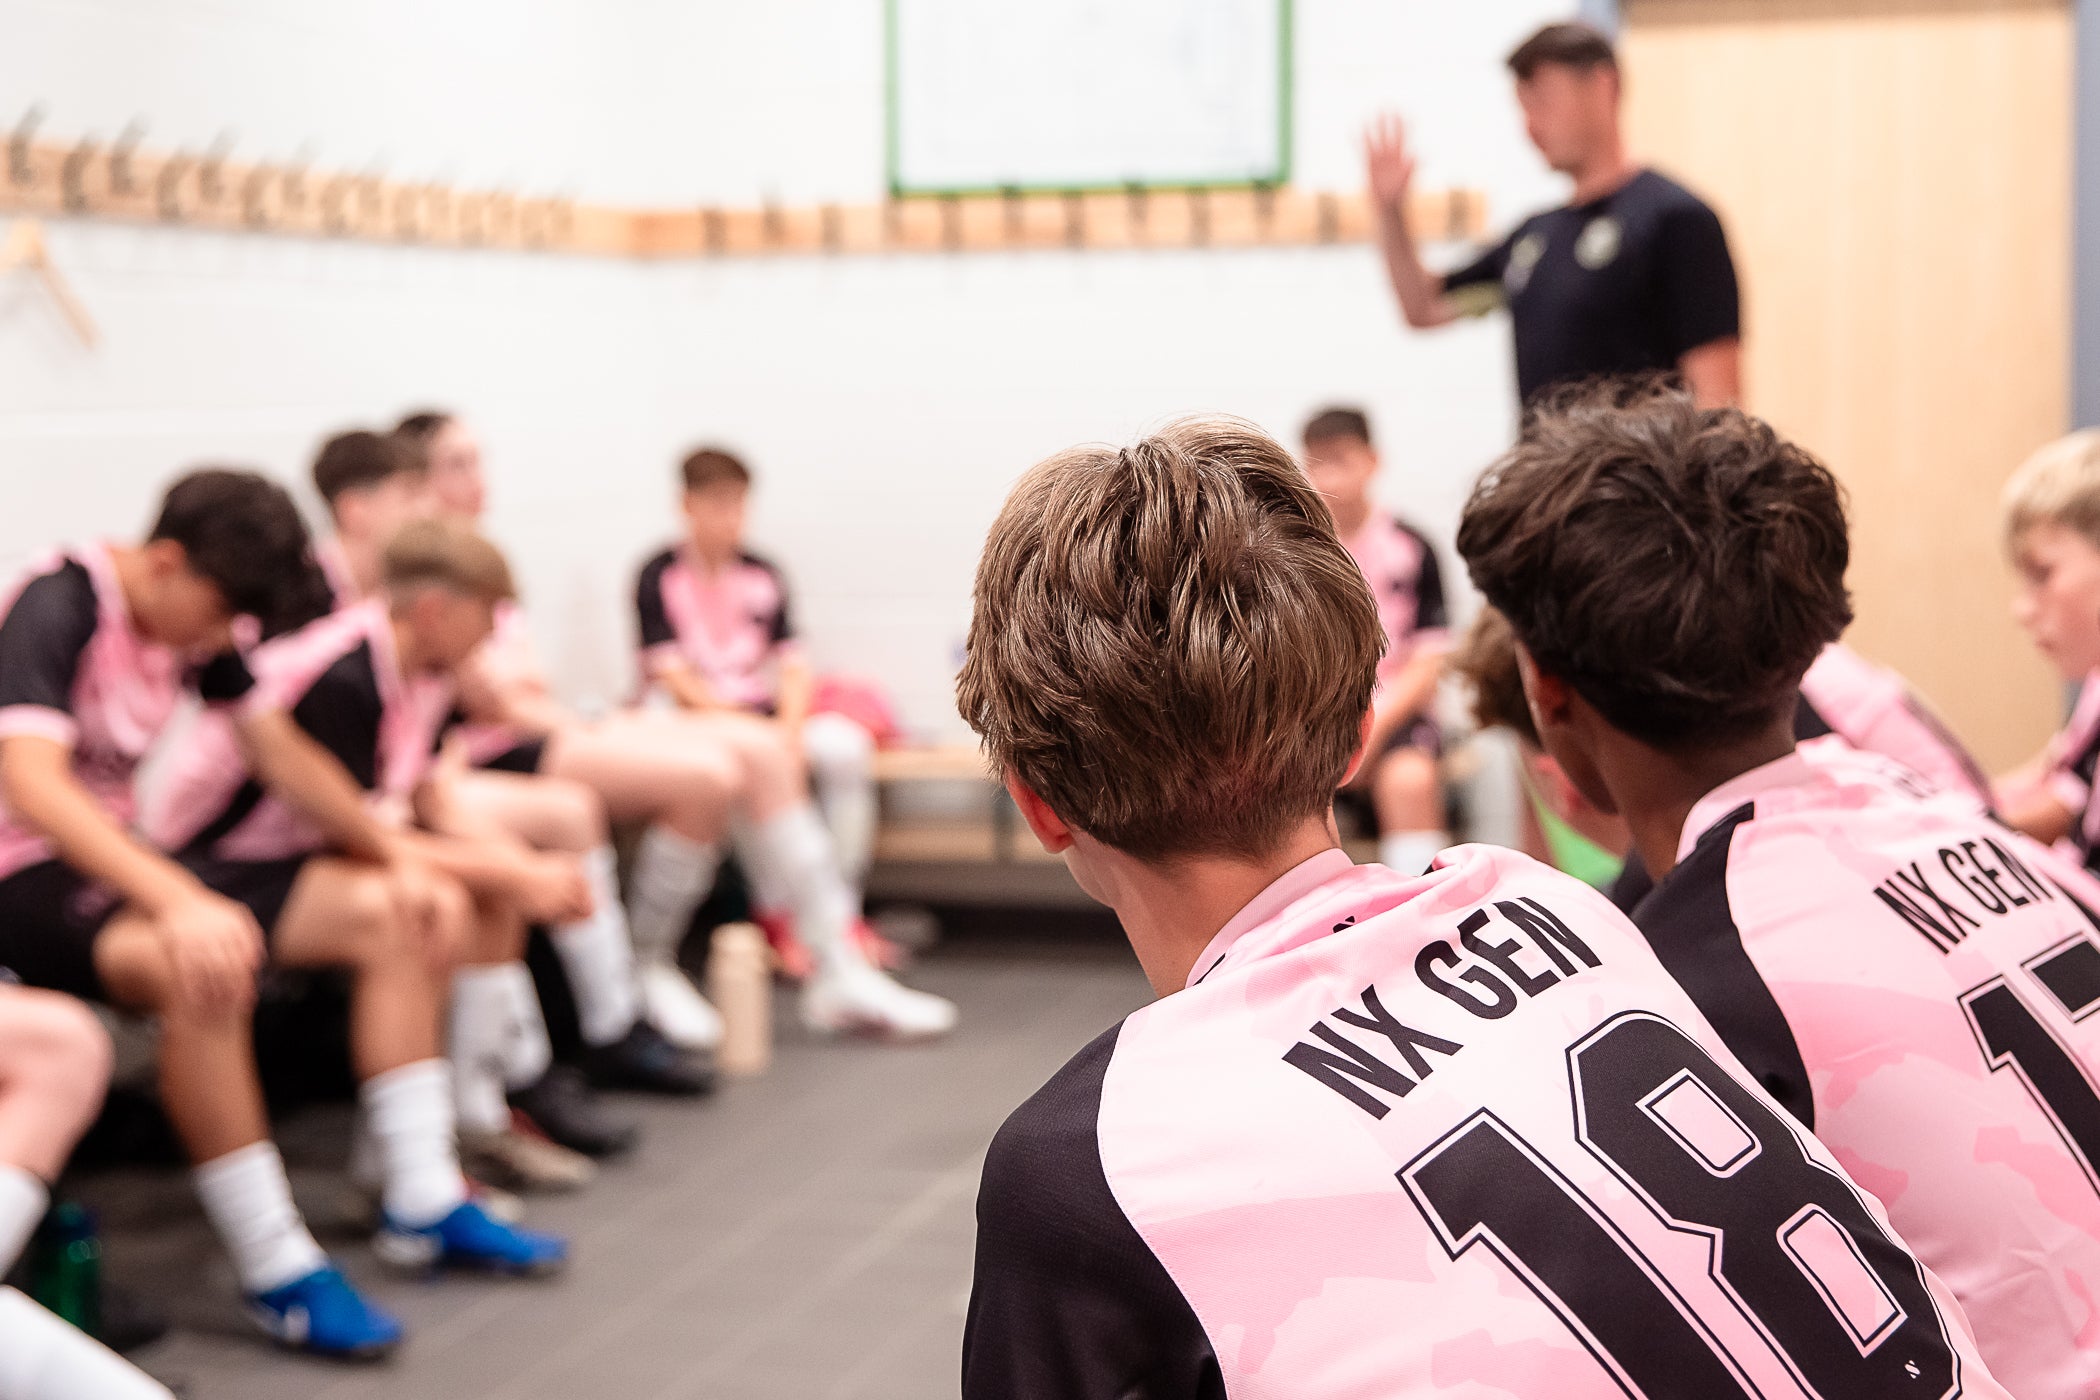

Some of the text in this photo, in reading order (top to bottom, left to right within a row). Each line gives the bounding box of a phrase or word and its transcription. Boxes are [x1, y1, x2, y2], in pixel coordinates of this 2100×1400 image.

[1282, 896, 1603, 1121] NX GEN
[1873, 837, 2053, 955] NX GEN
[1395, 1009, 1963, 1400] 18
